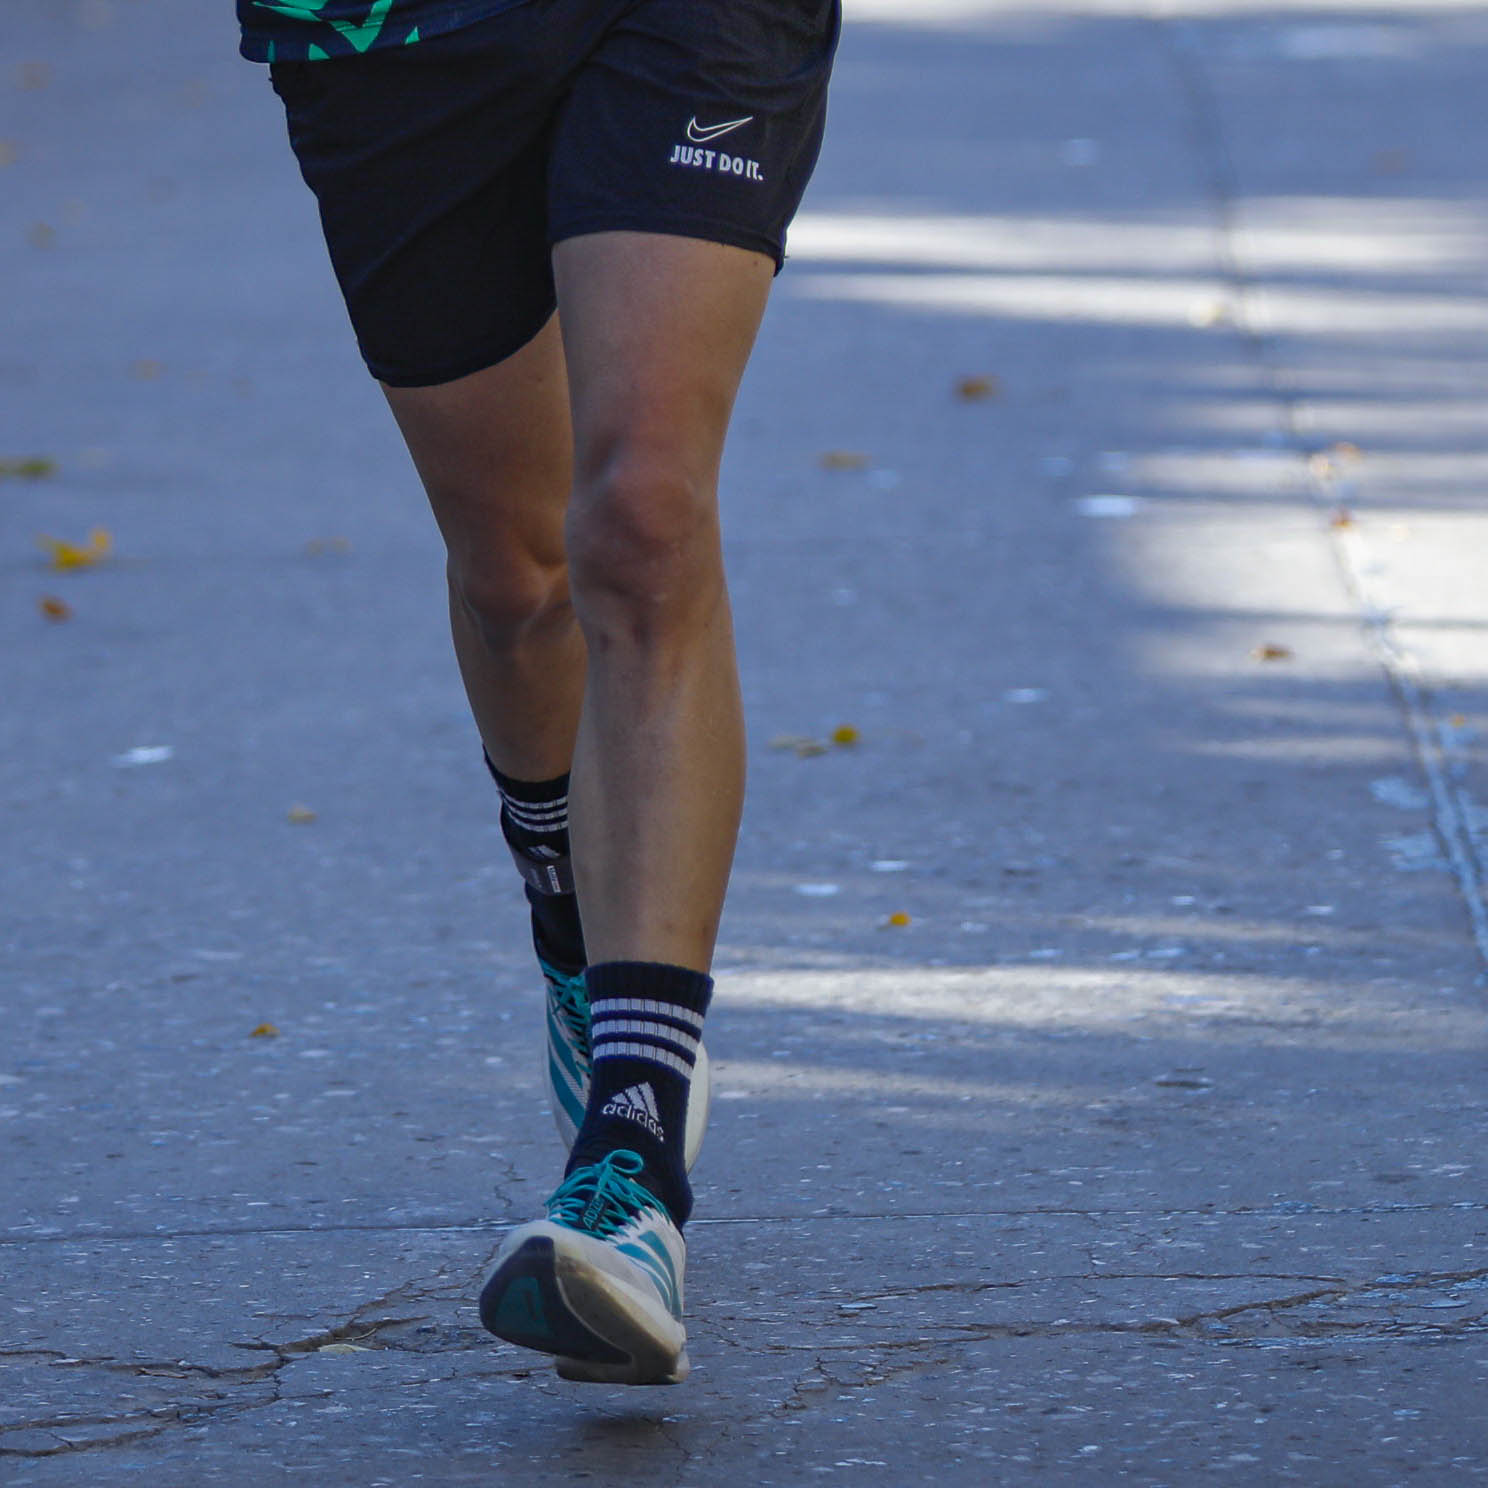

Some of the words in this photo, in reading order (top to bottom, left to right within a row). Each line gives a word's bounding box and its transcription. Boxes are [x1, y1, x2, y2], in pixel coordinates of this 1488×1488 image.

[670, 145, 716, 169] JUST
[719, 153, 744, 175] DO
[746, 159, 764, 180] IT.
[602, 1103, 664, 1142] adidas
